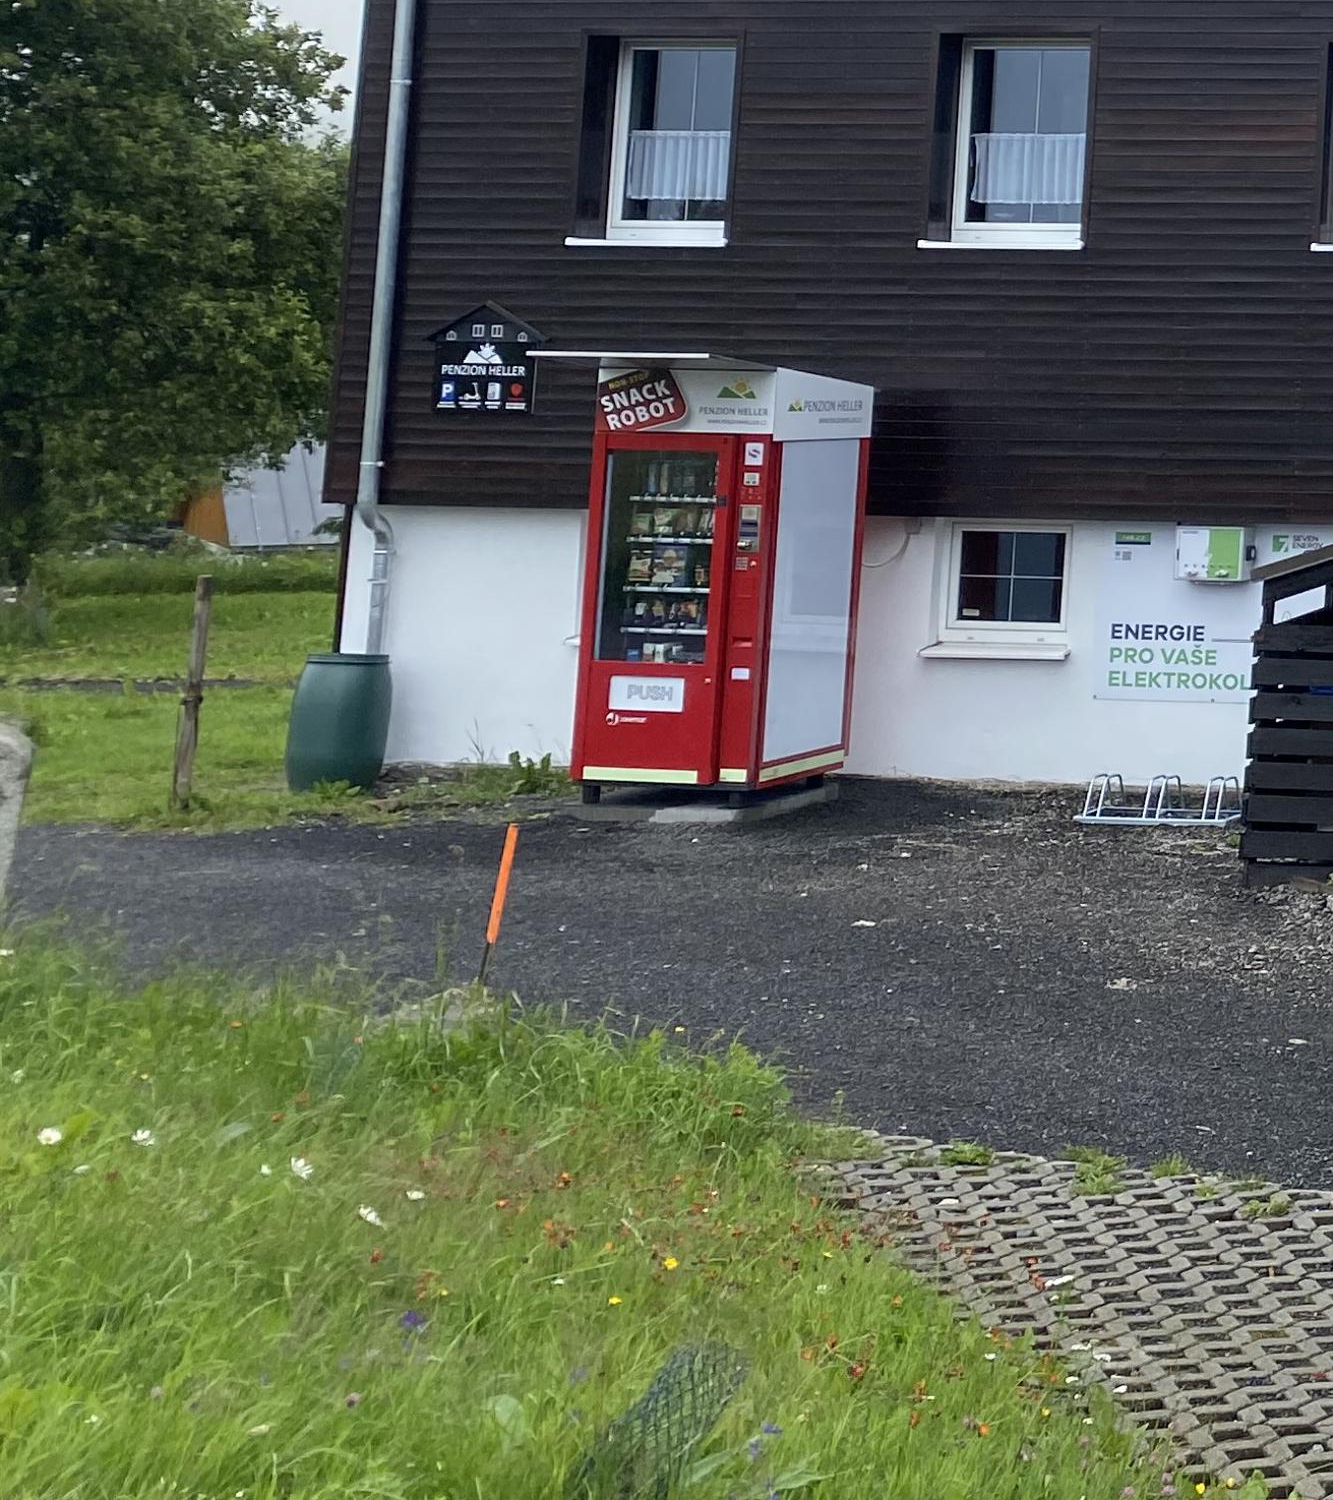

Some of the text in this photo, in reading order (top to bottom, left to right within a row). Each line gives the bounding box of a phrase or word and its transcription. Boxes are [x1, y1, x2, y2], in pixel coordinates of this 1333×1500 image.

[441, 364, 526, 377] PENZION HELLER
[600, 380, 671, 412] SNACK
[606, 397, 675, 431] ROBOT
[699, 406, 768, 417] PENZION HELLER
[804, 400, 863, 412] PENZION HELLER
[1110, 623, 1206, 642] ENERGIE
[1109, 644, 1217, 666] PRO VAŠE
[1108, 670, 1252, 690] ELEKTROKOL
[626, 683, 673, 701] PUSH
